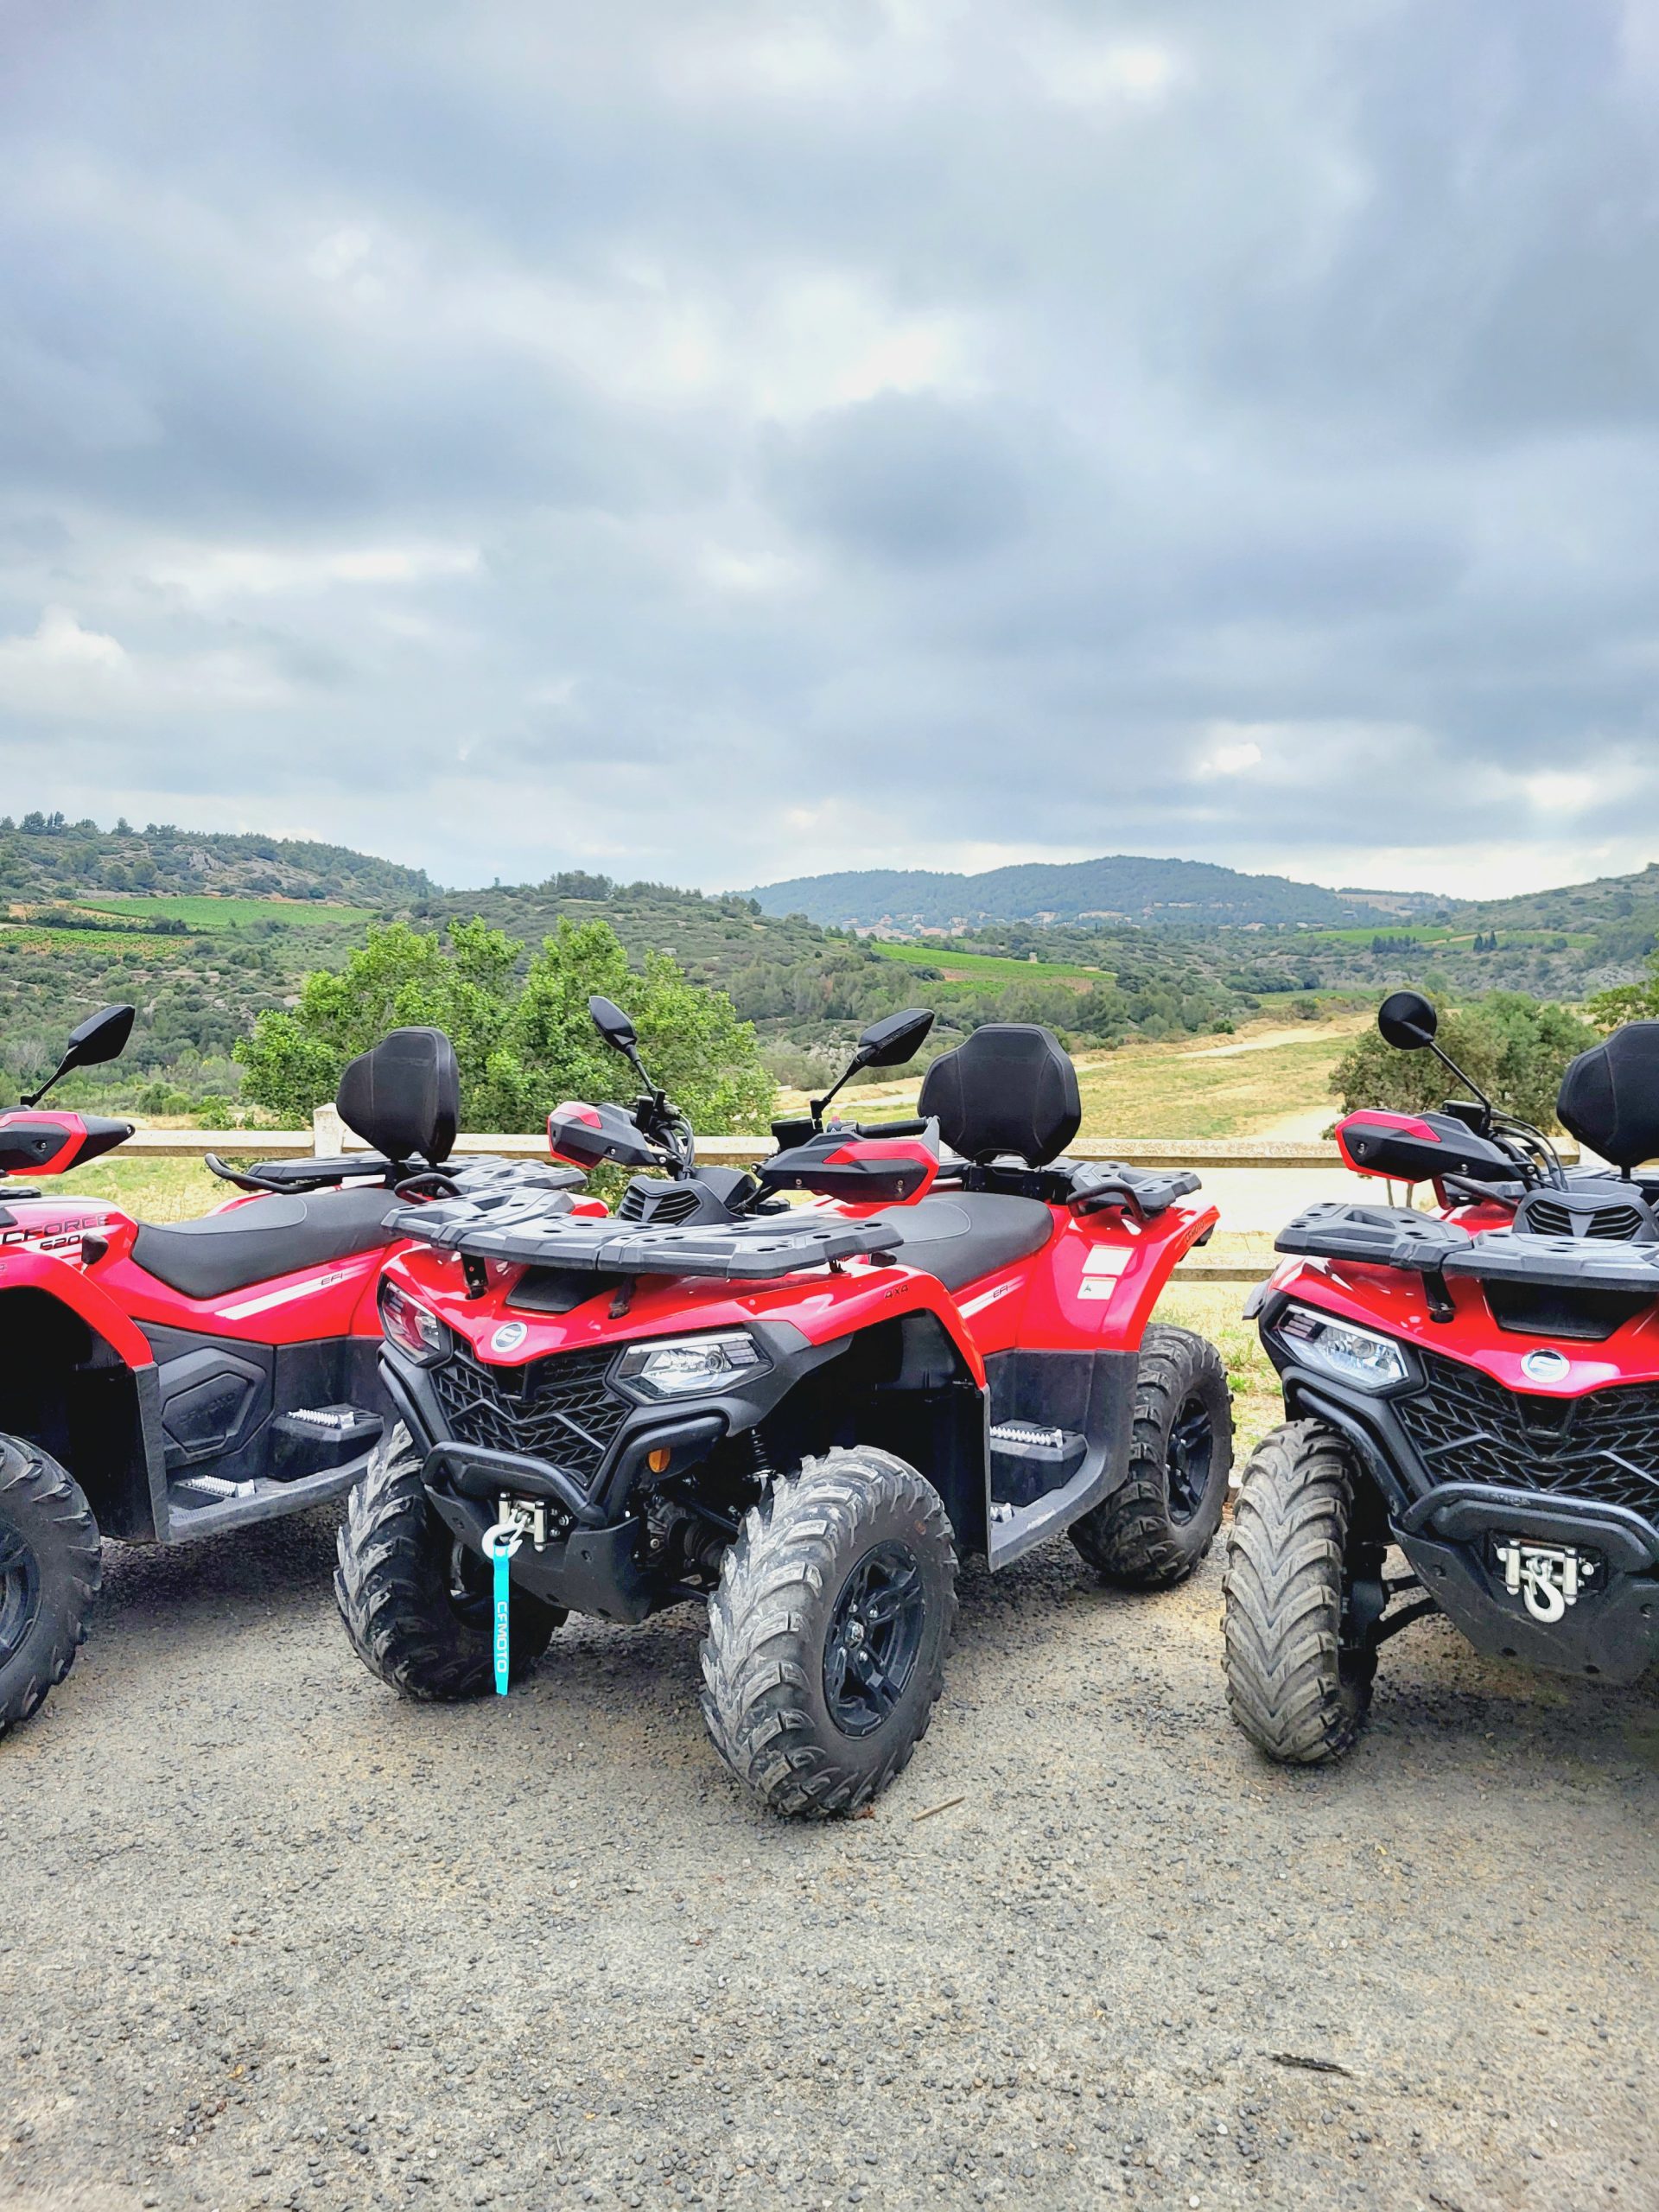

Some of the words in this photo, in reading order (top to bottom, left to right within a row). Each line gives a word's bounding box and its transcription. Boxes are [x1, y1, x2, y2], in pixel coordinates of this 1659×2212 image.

[2, 1215, 109, 1244] CFORCE
[321, 1272, 343, 1285] EFI
[993, 1285, 1008, 1298] EFI
[497, 1601, 508, 1673] CFMOTO
